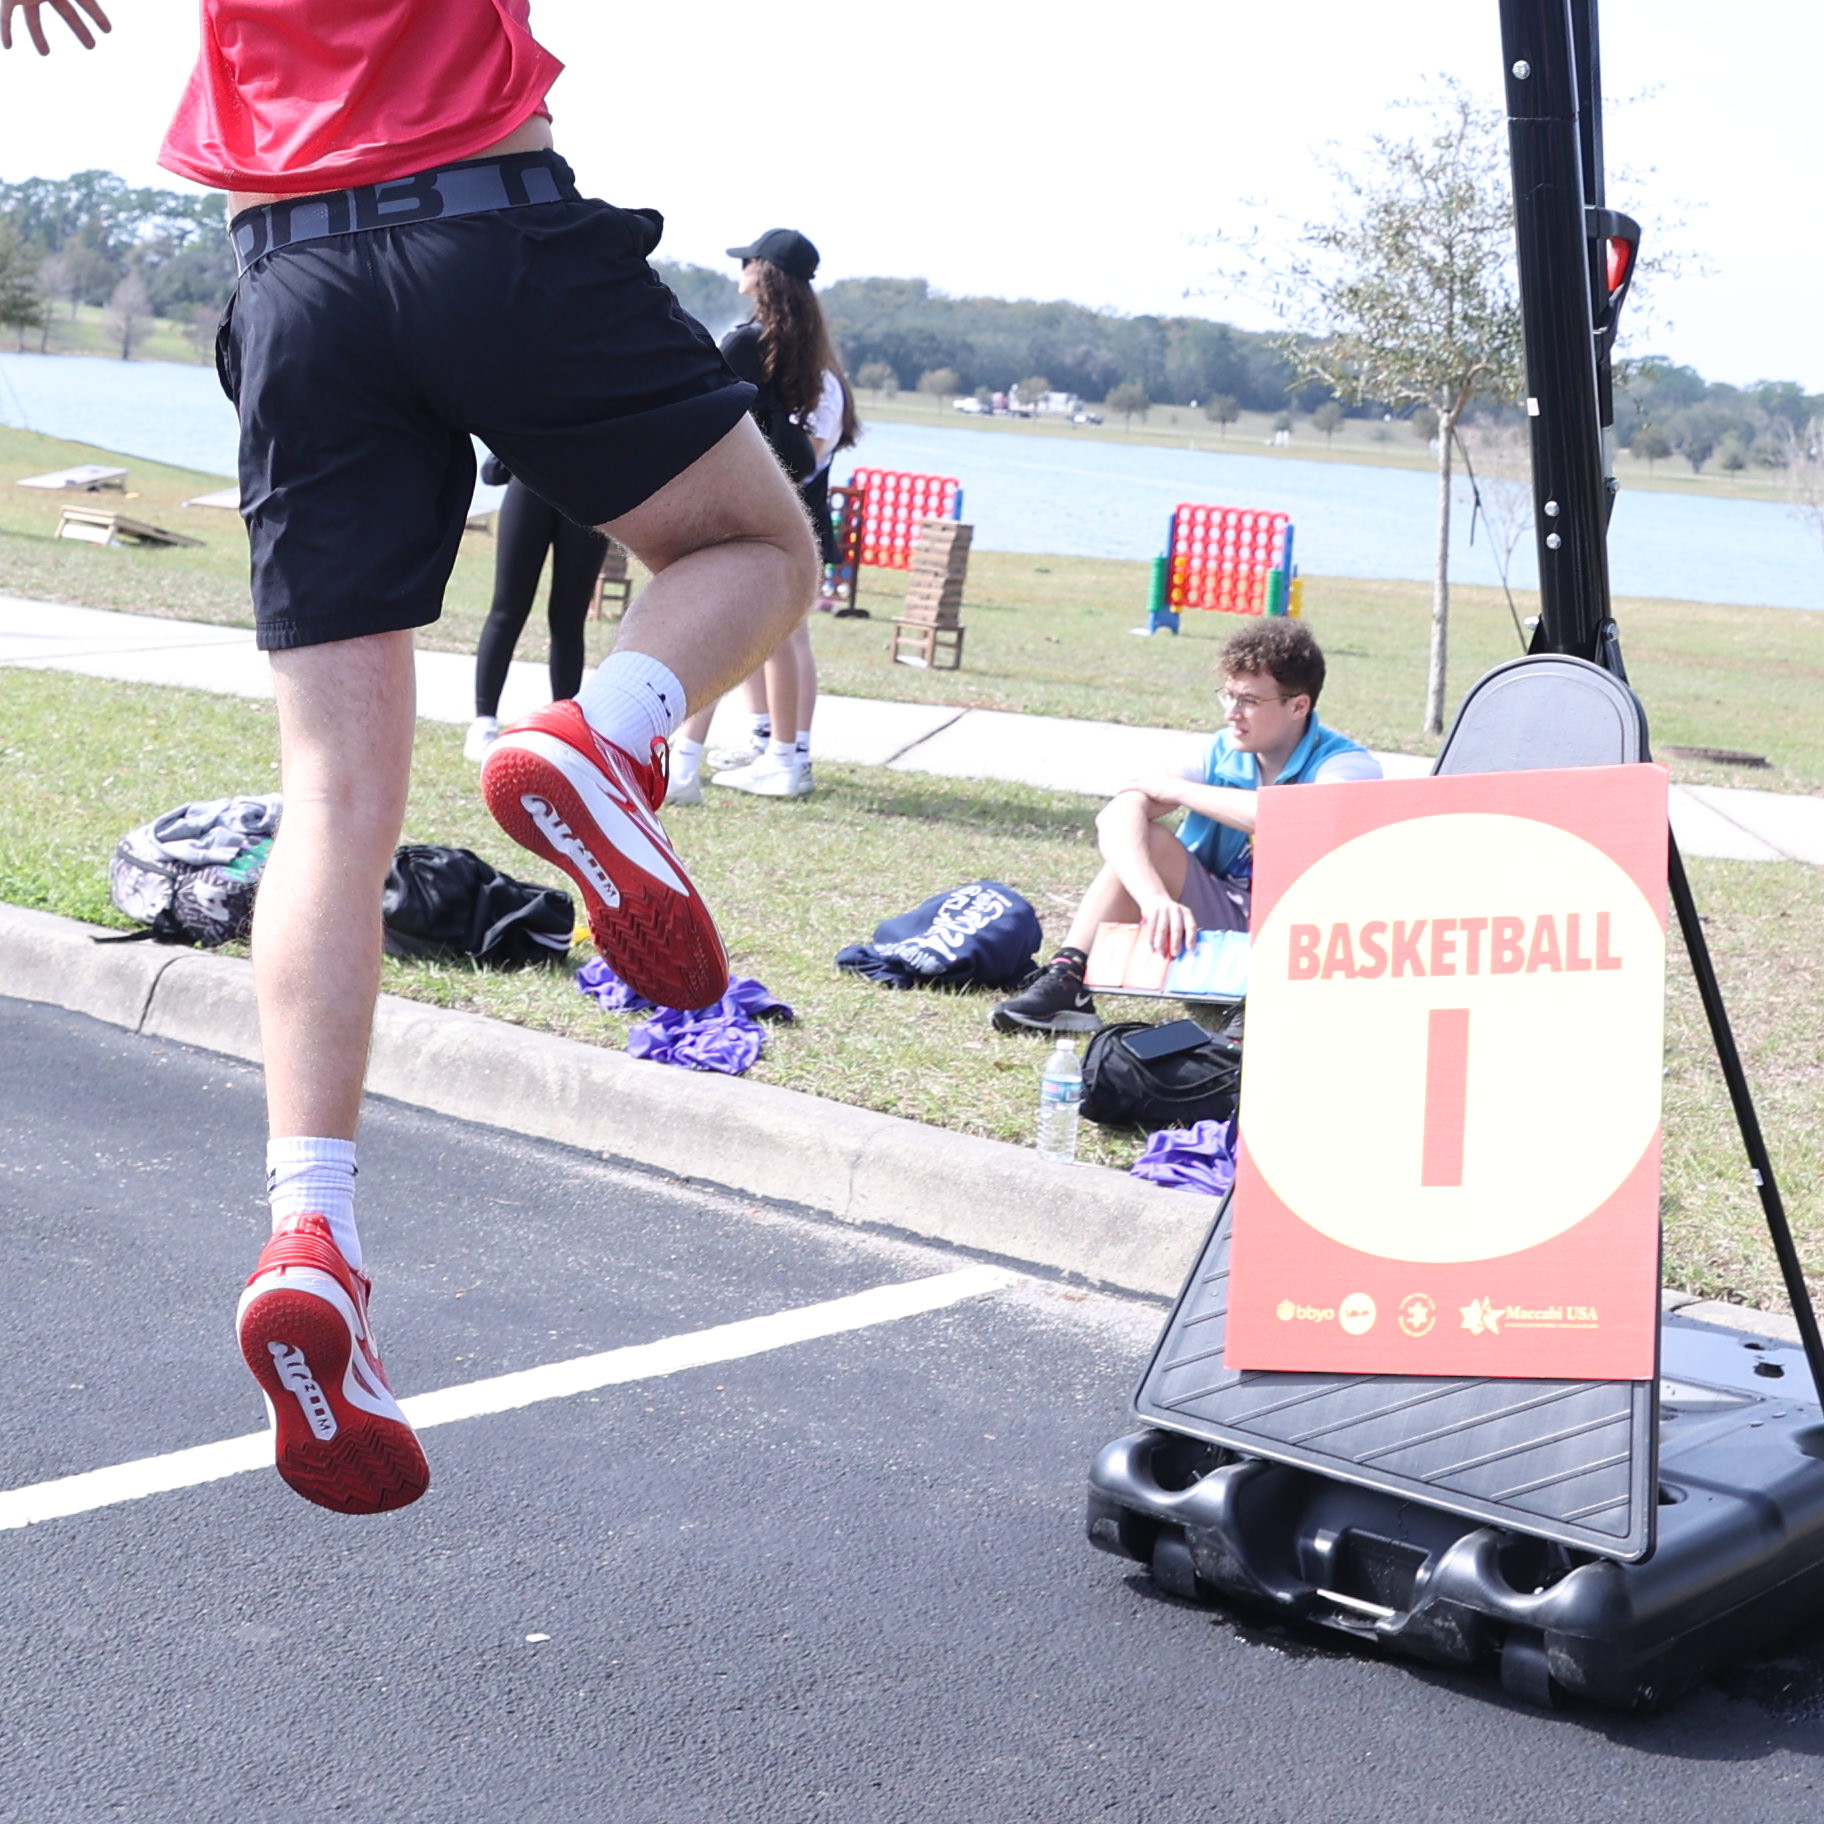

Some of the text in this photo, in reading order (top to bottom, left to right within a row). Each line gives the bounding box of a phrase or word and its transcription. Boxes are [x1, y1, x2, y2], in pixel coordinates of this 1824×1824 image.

[1287, 911, 1622, 980] BASKETBALL
[1296, 1304, 1335, 1322] bbyo
[1505, 1305, 1599, 1321] Maccabi USA
[304, 1384, 332, 1431] ZOOM
